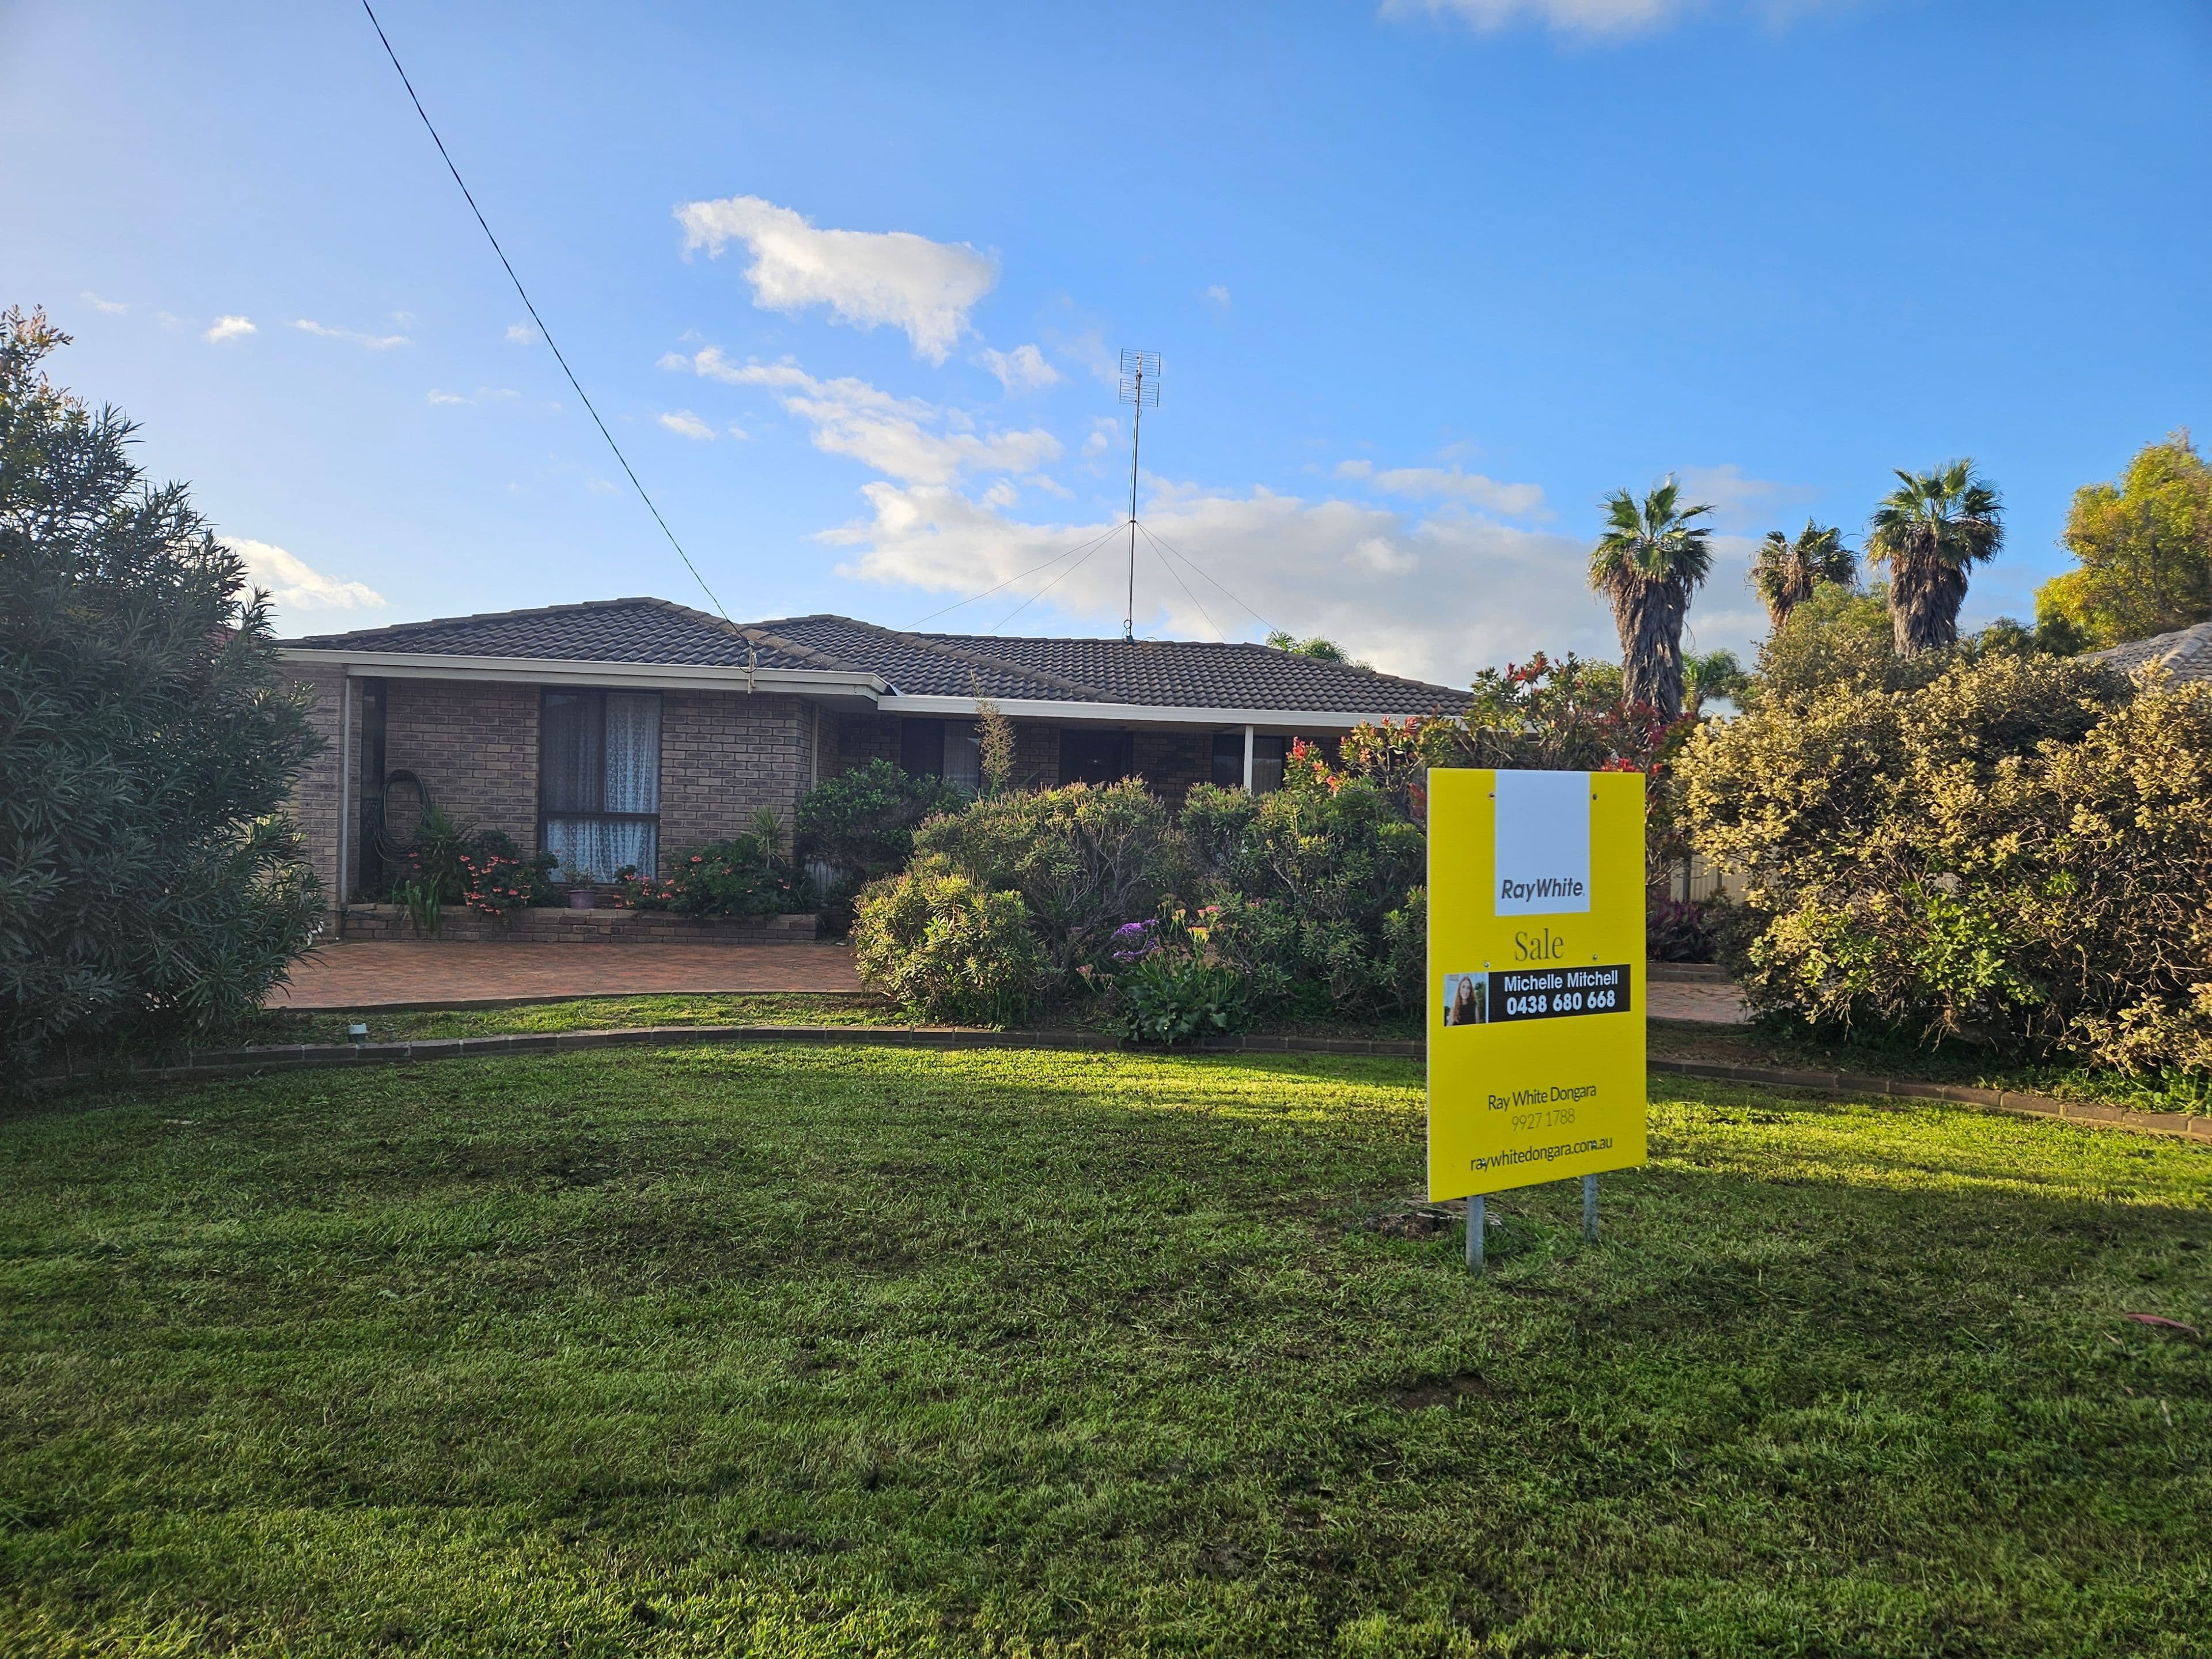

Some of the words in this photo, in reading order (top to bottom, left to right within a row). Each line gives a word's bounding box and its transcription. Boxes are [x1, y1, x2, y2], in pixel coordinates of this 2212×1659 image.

[1514, 927, 1565, 962] Sale
[1504, 974, 1563, 993] Michelle
[1567, 970, 1618, 988] Mitchell
[1506, 995, 1548, 1016] 0438
[1553, 993, 1582, 1012] 680
[1587, 990, 1616, 1009] 668
[1488, 1094, 1510, 1112] Ray
[1513, 1089, 1548, 1107] White
[1550, 1085, 1597, 1103] Dongara
[1511, 1112, 1542, 1132] 9927
[1547, 1108, 1576, 1127] 1788
[1470, 1137, 1612, 1173] raywhitedongara.com.au
